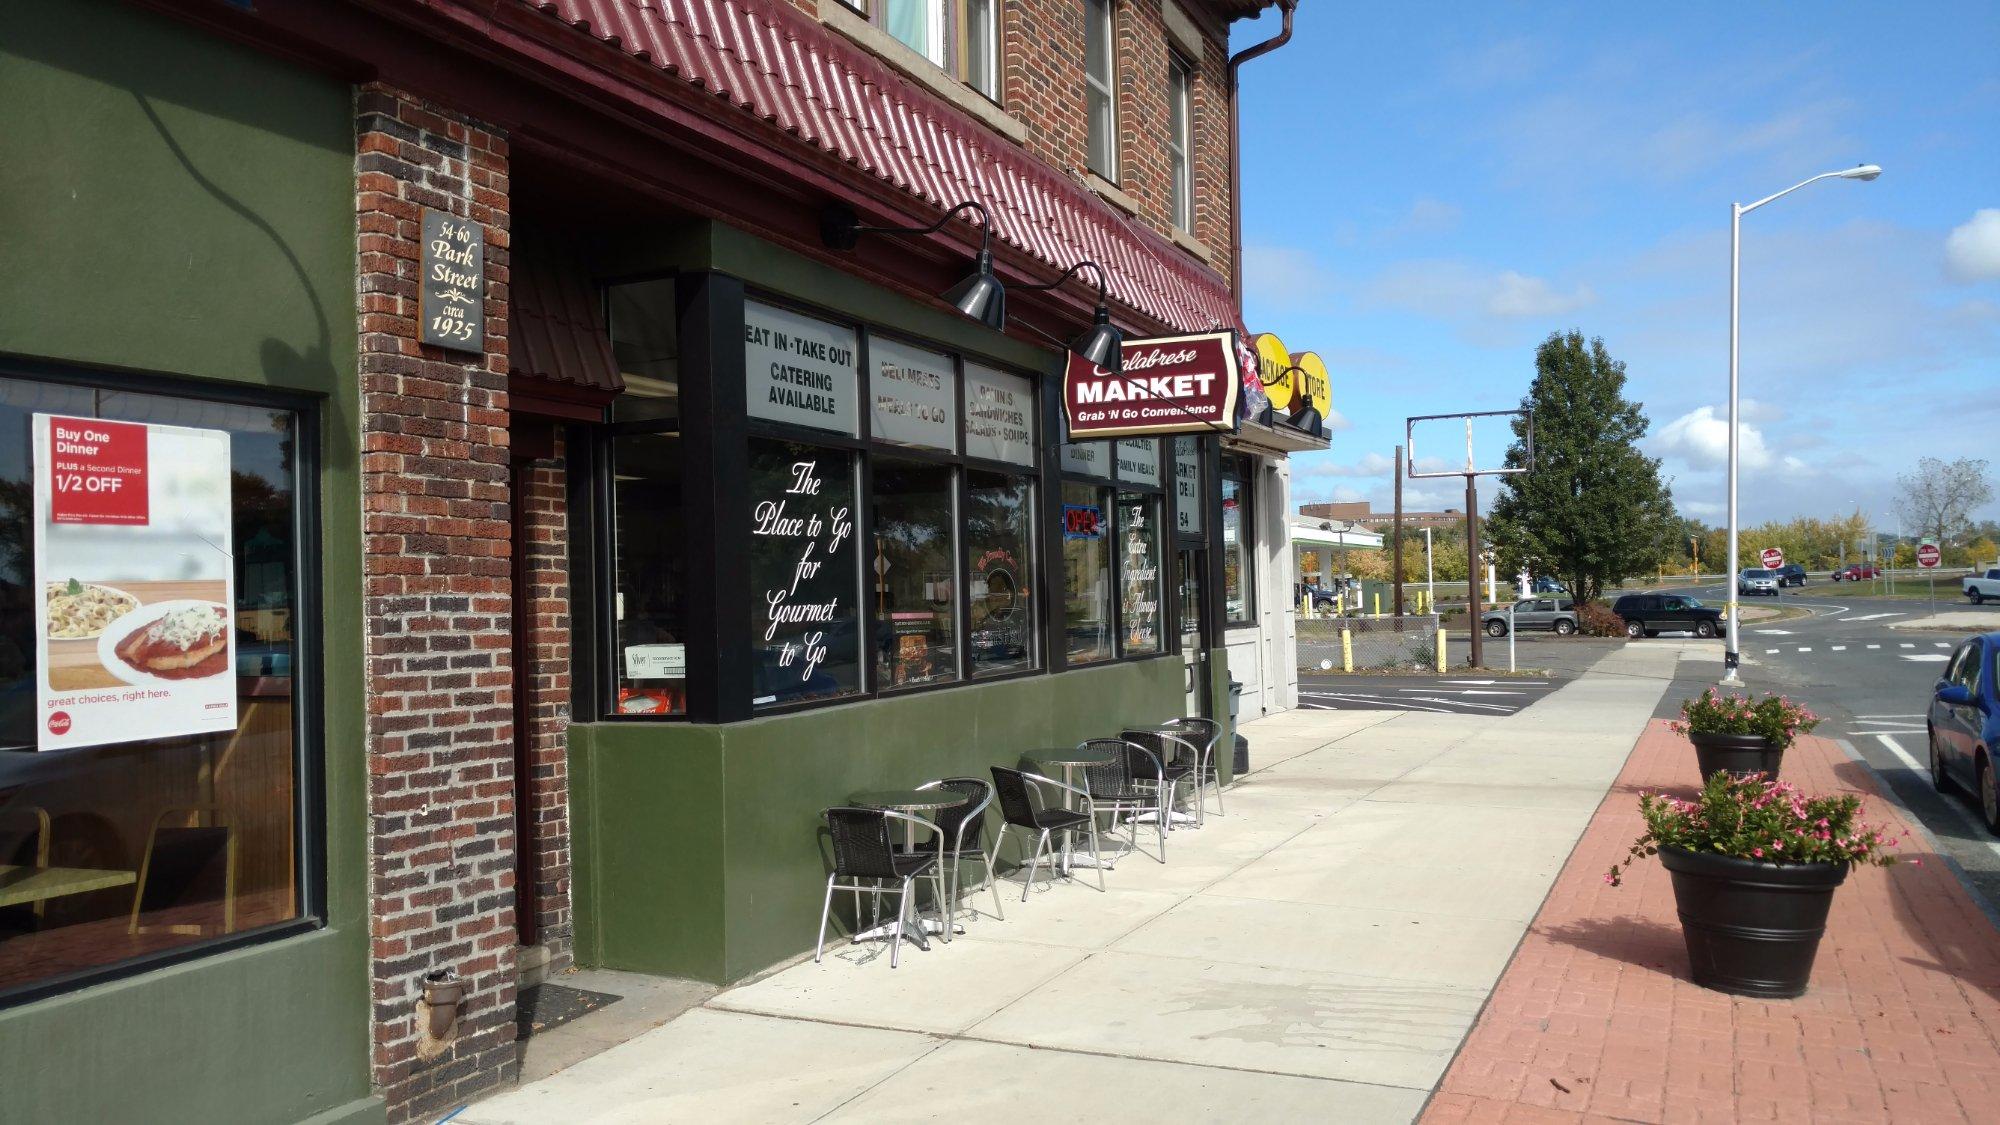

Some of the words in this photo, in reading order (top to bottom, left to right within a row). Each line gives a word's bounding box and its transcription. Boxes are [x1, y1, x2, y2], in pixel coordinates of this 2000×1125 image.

[439, 221, 470, 243] 54-60
[431, 240, 477, 267] Park
[431, 263, 479, 290] Street
[442, 301, 465, 318] circa
[432, 316, 476, 340] 1925
[745, 324, 770, 347] EAT
[828, 346, 851, 367] OUT
[770, 362, 832, 391] CATERING
[1260, 356, 1290, 389] ACKAGE
[1077, 372, 1216, 404] MARKET
[1306, 371, 1325, 400] TORE
[768, 385, 835, 415] AVAILABLE
[932, 407, 945, 424] GO
[1078, 411, 1105, 421] Grab
[1122, 408, 1138, 419] Go
[1141, 404, 1216, 418] Convenience
[56, 427, 80, 442] Buy
[84, 430, 110, 443] One
[1003, 427, 1029, 445] SOUPS
[56, 441, 99, 455] Dinner
[1070, 447, 1095, 462] DINNER
[56, 462, 78, 470] PLUS
[87, 464, 115, 473] Second
[117, 466, 142, 475] Dinner
[785, 460, 821, 495] The
[1176, 461, 1196, 479] ARKET
[55, 473, 83, 493] 1/2
[86, 476, 122, 493] OFF
[1179, 481, 1194, 498] DEI
[753, 499, 803, 537] Place
[807, 513, 822, 537] to
[829, 505, 852, 554] Go
[1067, 509, 1097, 533] OPEN
[1129, 504, 1145, 528] The
[1179, 511, 1189, 527] 54
[790, 541, 821, 596] for
[765, 589, 838, 641] Gourmet
[779, 641, 796, 667] to
[802, 631, 827, 682] Go
[47, 697, 76, 709] great
[78, 692, 120, 704] choices,
[122, 691, 145, 701] right
[147, 689, 171, 698] here.
